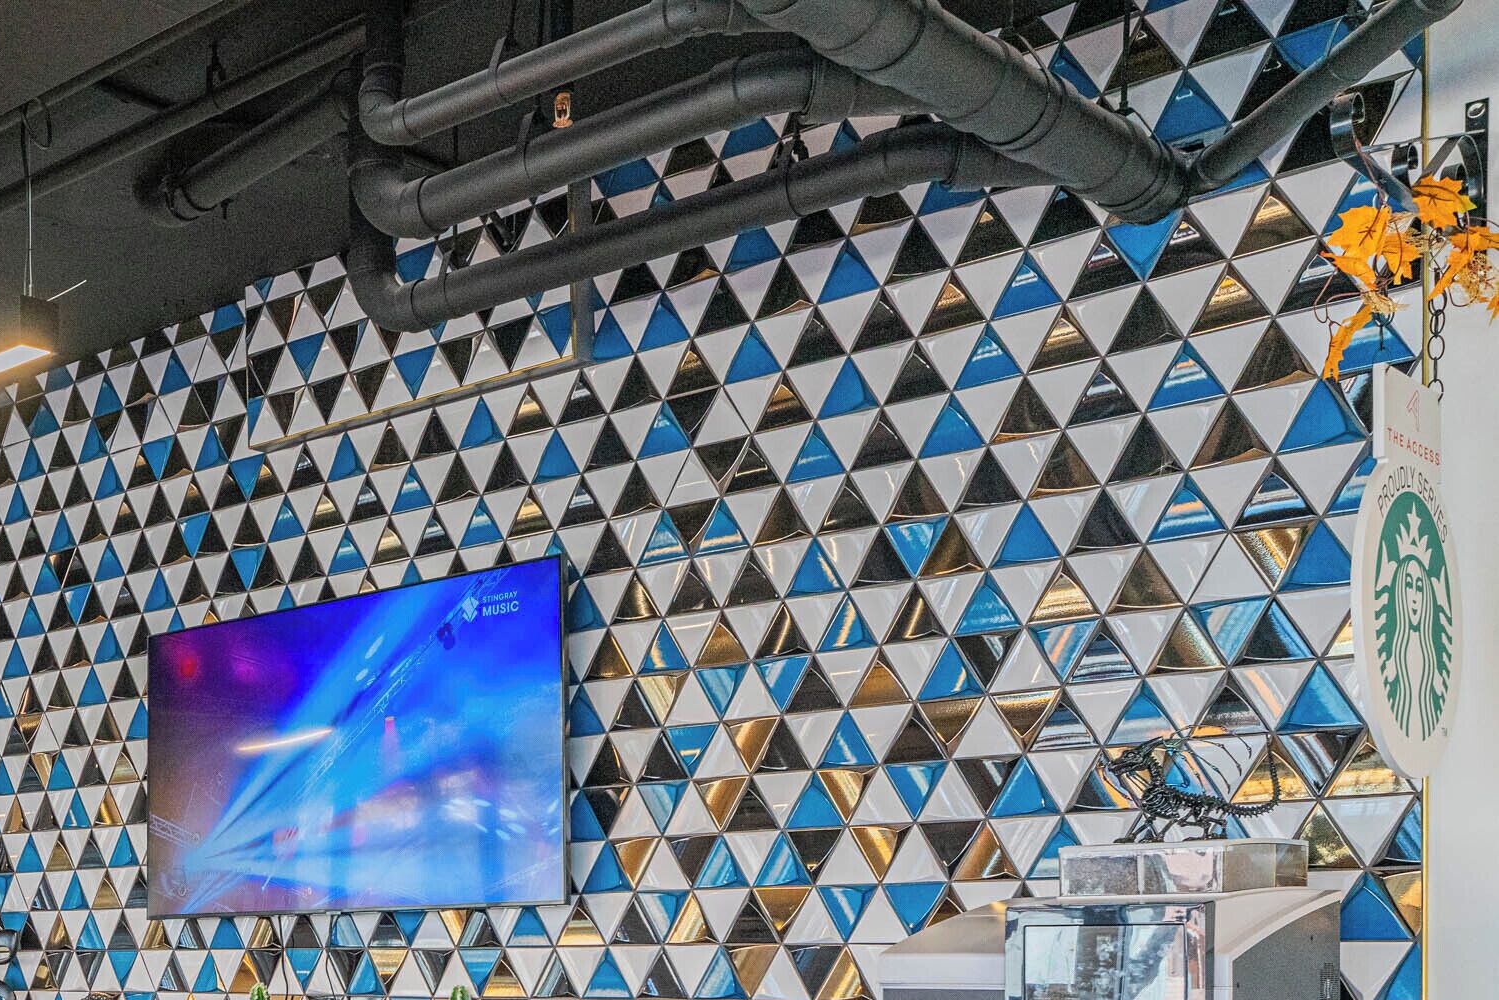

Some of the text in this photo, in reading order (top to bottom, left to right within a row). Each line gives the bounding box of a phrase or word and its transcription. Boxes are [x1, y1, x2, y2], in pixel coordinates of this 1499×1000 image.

[1386, 427, 1441, 467] THE ACCESS
[1377, 465, 1448, 544] PROUDLY SERVES
[482, 591, 518, 603] STINGRAY
[482, 601, 519, 617] MUSIC
